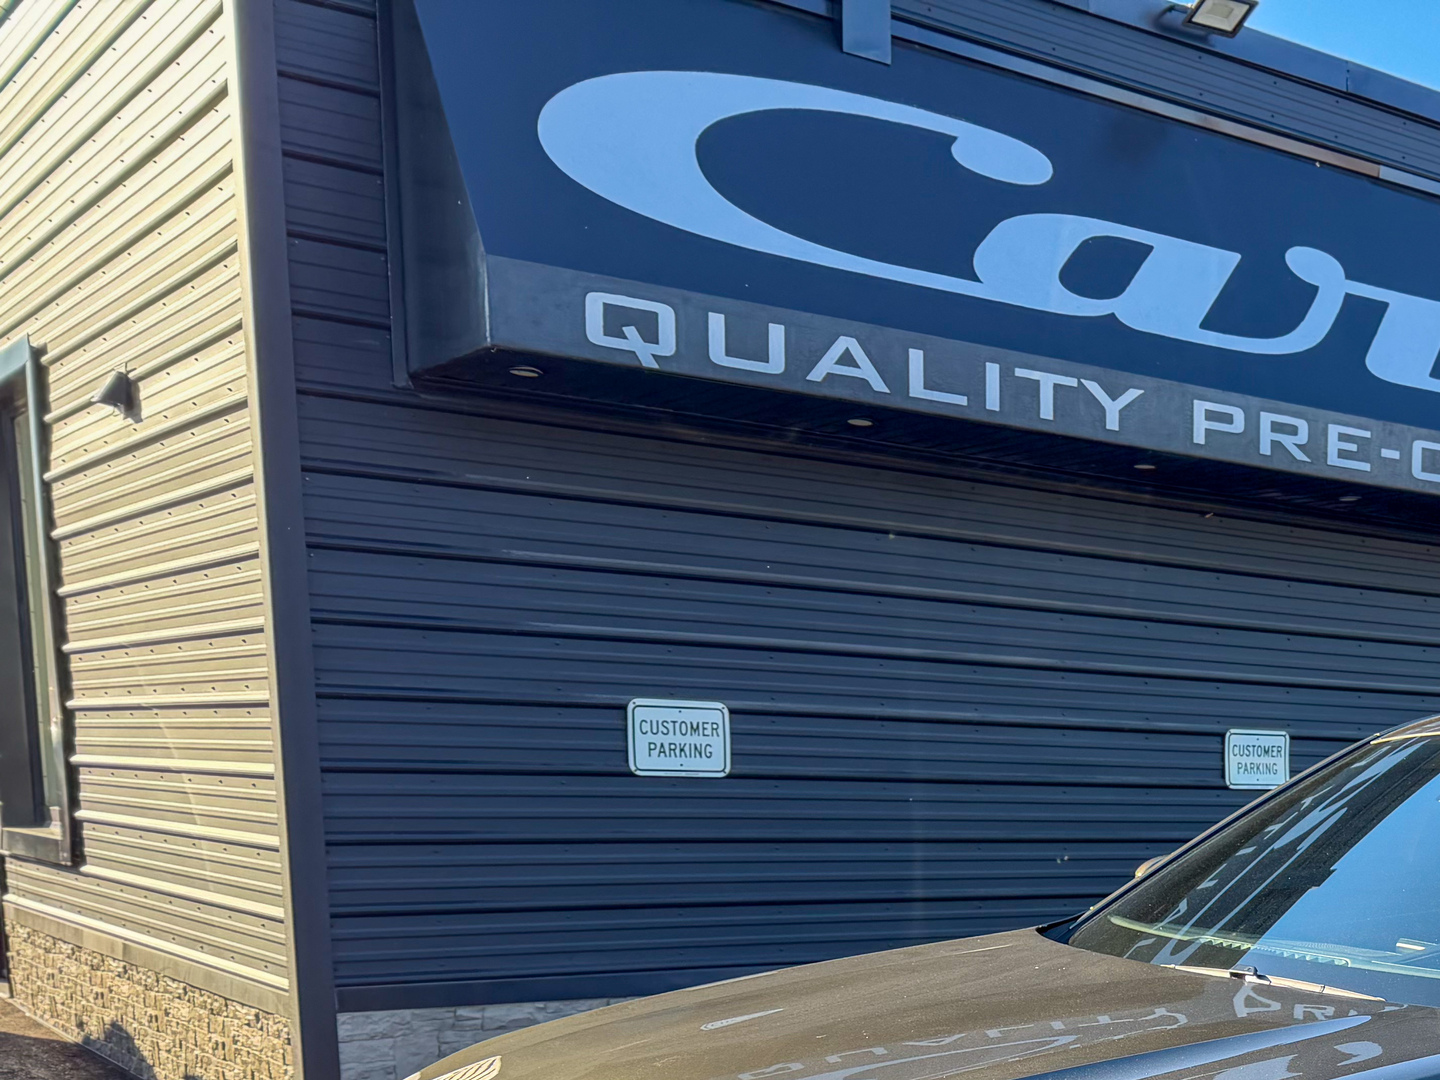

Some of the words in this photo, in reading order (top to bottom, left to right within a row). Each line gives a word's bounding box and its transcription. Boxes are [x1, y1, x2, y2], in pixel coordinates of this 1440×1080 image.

[585, 291, 1145, 432] QUALITY
[639, 719, 720, 737] CUSTOMER
[647, 741, 713, 759] PARKING
[1232, 744, 1282, 758] CUSTOMER
[1237, 762, 1278, 775] PARKING
